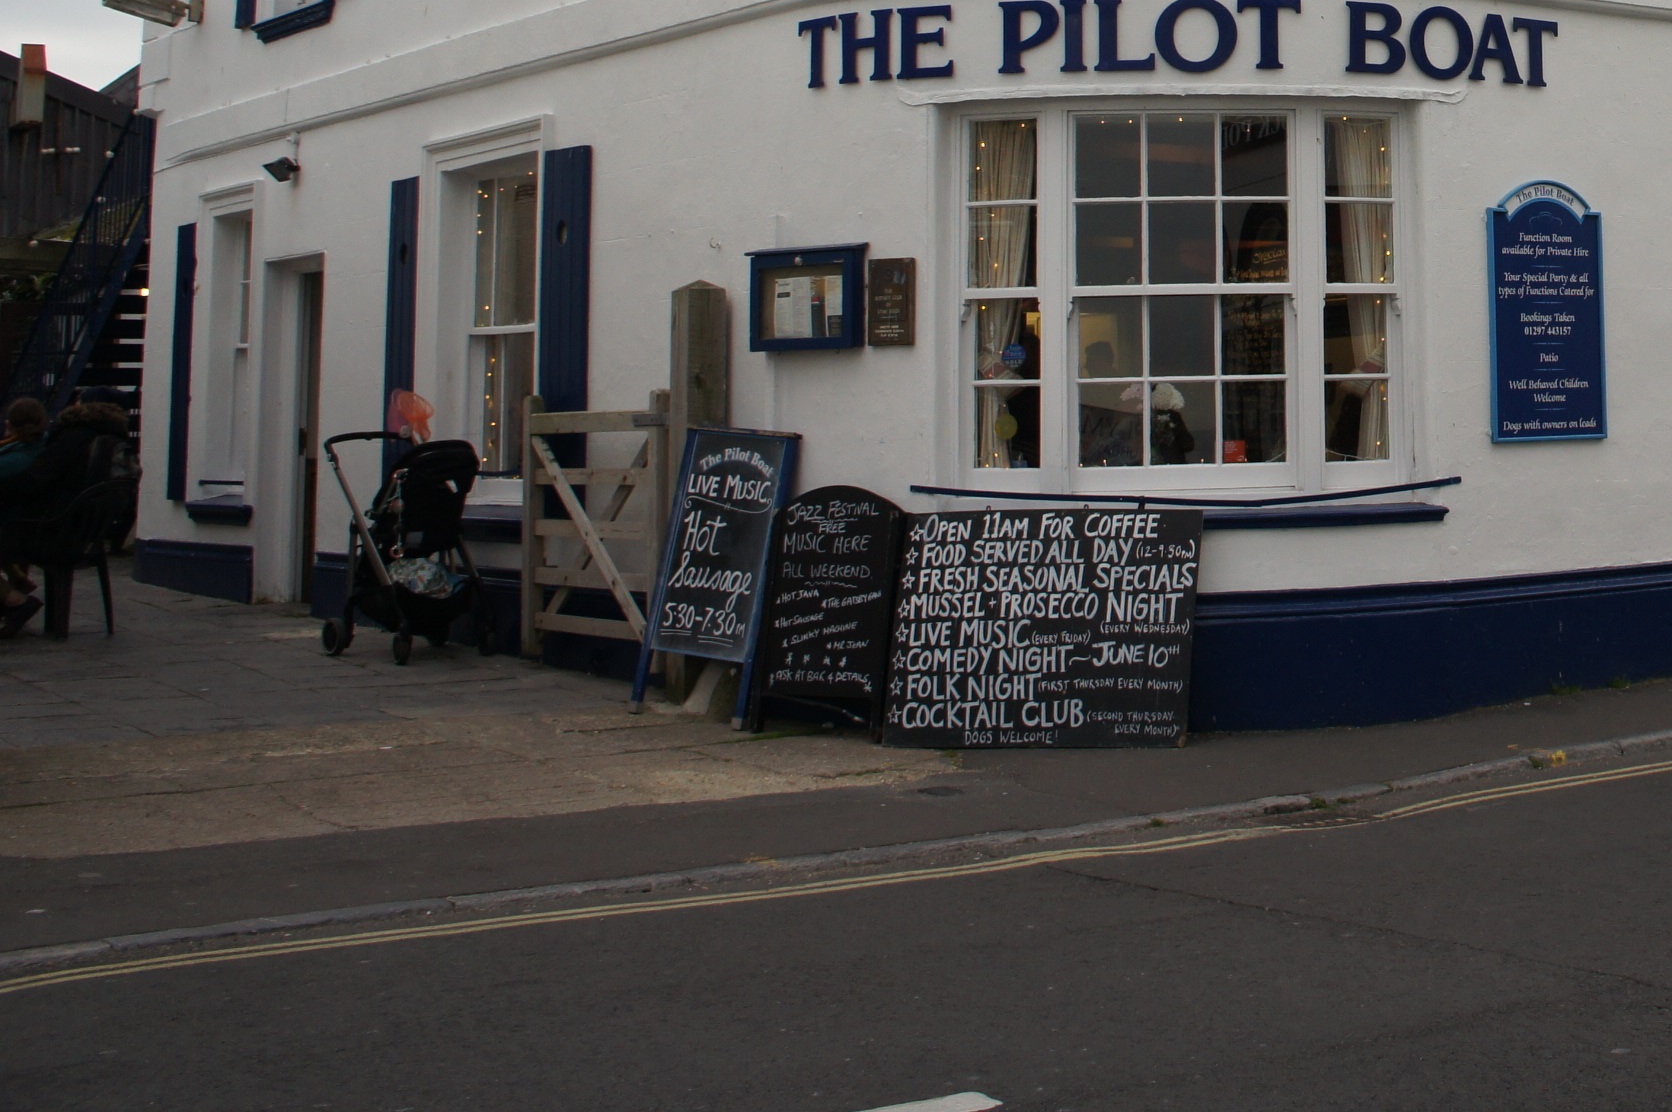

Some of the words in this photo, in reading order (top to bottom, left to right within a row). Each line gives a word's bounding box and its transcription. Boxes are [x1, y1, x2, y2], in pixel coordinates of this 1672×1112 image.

[799, 5, 953, 88] THE
[1346, 0, 1559, 87] BOAT
[1515, 190, 1532, 204] The
[1534, 185, 1555, 196] Pilot
[1556, 188, 1575, 206] Boat
[1519, 232, 1551, 242] Function
[1552, 233, 1572, 243] Room
[1501, 244, 1534, 255] available
[1534, 245, 1545, 258] for
[1547, 246, 1572, 256] Private
[1573, 247, 1589, 257] Hire
[1503, 272, 1522, 282] Your
[1522, 272, 1548, 285] Special
[1549, 273, 1568, 286] Party
[1569, 274, 1578, 283] &
[1579, 272, 1589, 283] all
[1498, 285, 1516, 299] types
[1517, 284, 1525, 299] of
[1526, 285, 1557, 296] Functions
[1559, 285, 1584, 296] Catered
[1584, 285, 1595, 299] for
[1520, 311, 1552, 326] Bookings
[1553, 312, 1575, 322] Taken
[1524, 326, 1545, 336] 01297
[1547, 326, 1572, 335] 443157
[1540, 352, 1559, 362] Patio
[1509, 379, 1527, 389] Well
[1529, 378, 1558, 389] Behaved
[1559, 377, 1589, 388] Children
[1533, 392, 1566, 402] Welcome
[1503, 421, 1522, 434] Dogs
[1523, 419, 1541, 430] with
[1542, 420, 1567, 429] owners
[1569, 420, 1578, 428] on
[1579, 417, 1597, 428] leads
[699, 452, 722, 472] The
[724, 446, 749, 463] Pilot
[751, 451, 774, 478] Boat
[688, 473, 721, 497] LIVE
[723, 474, 772, 503] MUSIC
[787, 502, 825, 525] JAZZ
[827, 499, 880, 519] FESTIVAL
[683, 510, 728, 557] Hot
[818, 522, 847, 534] FREE
[922, 513, 972, 542] OPEN
[982, 512, 1028, 540] 11AM
[1038, 512, 1074, 540] FOR
[1084, 513, 1161, 539] COFFEE
[783, 532, 827, 554] MUSIC
[833, 534, 872, 555] HERE
[921, 543, 966, 568] FOOD
[970, 540, 1044, 564] SERVED
[1045, 540, 1085, 564] ALL
[1092, 538, 1134, 566] DAY
[782, 561, 804, 579] ALL
[918, 567, 979, 593] FRESH
[982, 564, 1089, 593] SEASONAL
[1092, 562, 1197, 592] SPECIALS
[668, 551, 752, 613] Sausage
[781, 592, 797, 604] HOT
[797, 589, 820, 600] JAVA
[909, 592, 985, 619] MUSSEL
[988, 597, 997, 609] +
[999, 592, 1099, 619] PROSECCO
[1105, 590, 1184, 624] NIGHT
[909, 623, 952, 647] LIVE
[958, 619, 1031, 649] MUSIC
[1031, 631, 1058, 645] (EVERY
[1061, 630, 1091, 645] FRIDAY)
[1099, 621, 1130, 635] (EVERY
[1134, 618, 1190, 636] WEDNESDAY)
[906, 646, 993, 674] COMEDY
[999, 644, 1074, 674] NIGHT
[1091, 641, 1145, 668] JUNE
[906, 674, 961, 701] FOLK
[967, 672, 1042, 701] NIGHT
[1038, 679, 1069, 693] (FIRST
[1073, 677, 1114, 690] THURSDAY
[1118, 677, 1144, 690] EVERY
[1147, 679, 1184, 693] MONTH)
[901, 700, 1013, 729] COCKTAIL
[1021, 698, 1085, 728] CLUB
[1086, 710, 1123, 723] (SECOND
[1126, 709, 1175, 722] THURSDAY
[964, 730, 993, 745] DOGS
[999, 729, 1059, 745] WELCOME!
[1114, 723, 1140, 735] EVERY
